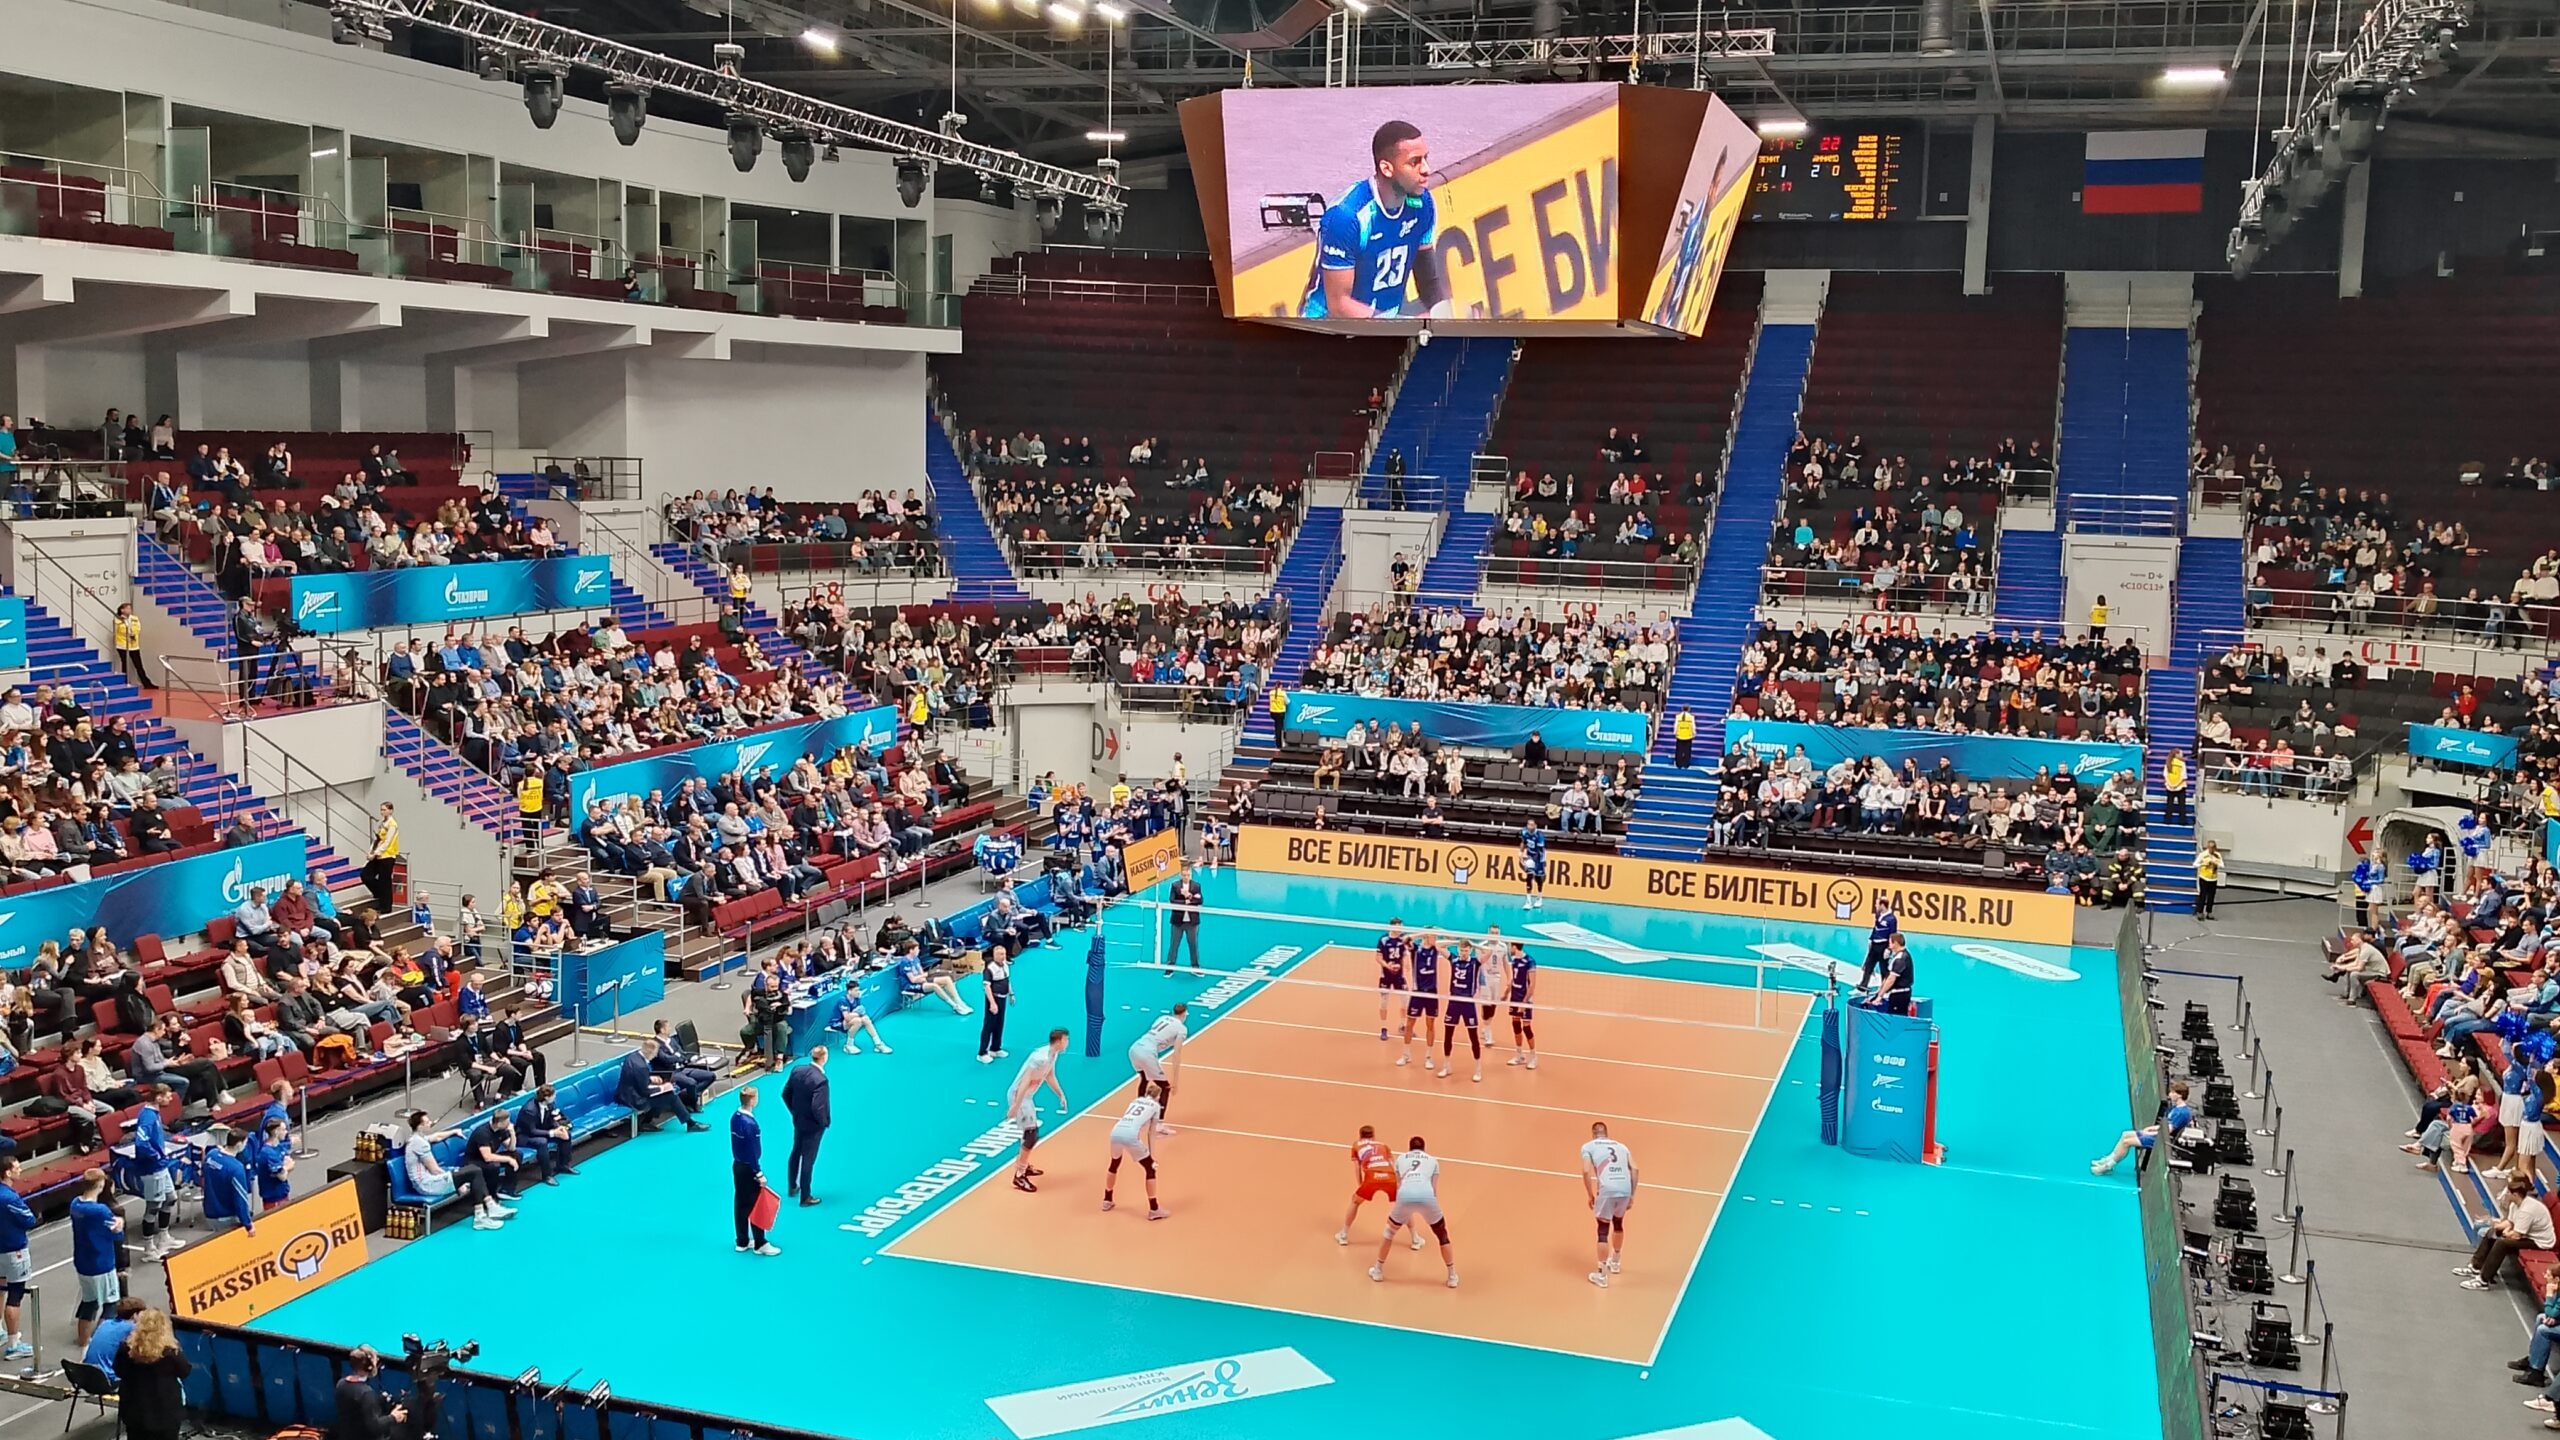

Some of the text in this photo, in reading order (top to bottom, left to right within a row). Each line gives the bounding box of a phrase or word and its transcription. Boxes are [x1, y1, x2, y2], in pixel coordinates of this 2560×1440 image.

[1820, 137, 1841, 150] 22
[1811, 165, 1820, 178] 2
[1373, 246, 1408, 291] 23
[98, 586, 109, 596] C7
[1860, 612, 1917, 636] C10
[2361, 638, 2421, 667] C11
[1093, 722, 1104, 761] D
[1130, 859, 1155, 877] KASSIR
[1287, 837, 1439, 874] ВСЕ БИЛЕТЫ
[1485, 854, 1613, 890] KAIR.RU
[1647, 868, 1817, 909] ВСЕ БИЛЕТЫ
[1411, 1160, 1421, 1171] 9
[1607, 1147, 1617, 1163] 3
[190, 1219, 360, 1315] KASSIR RU
